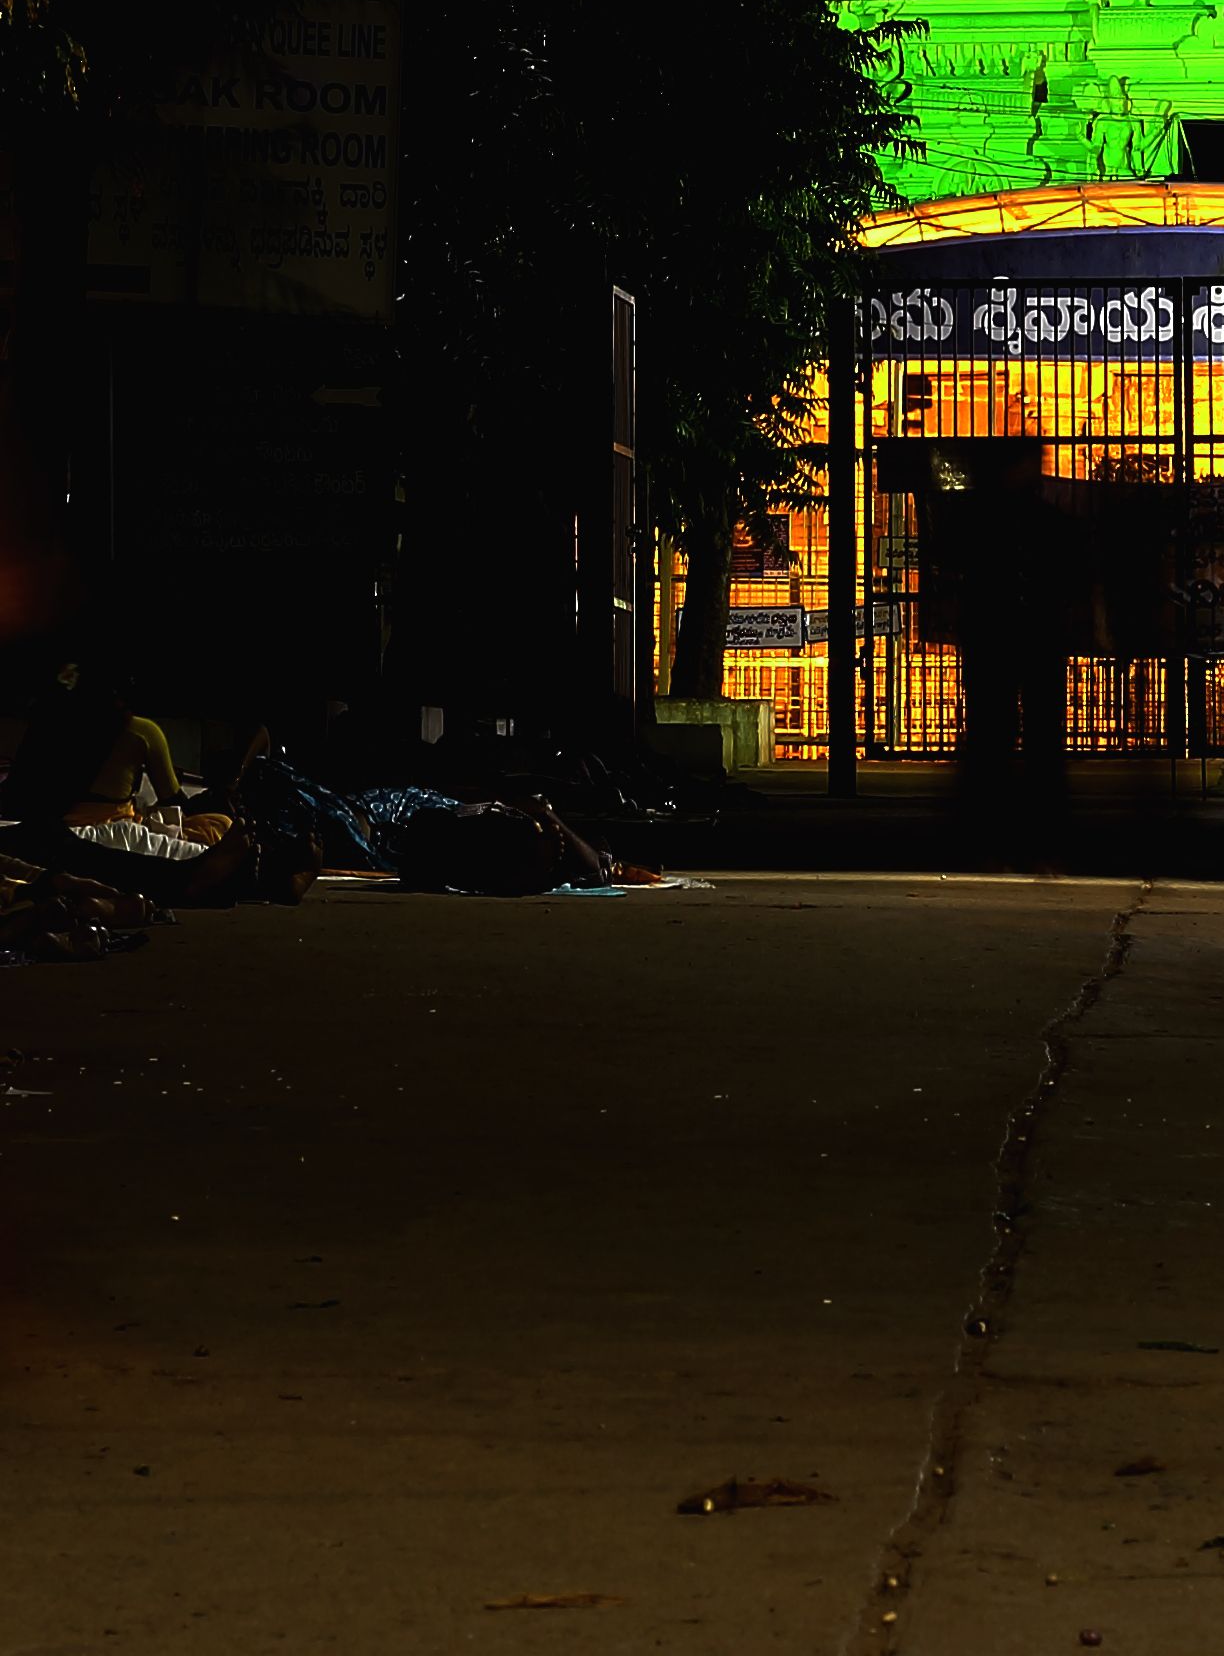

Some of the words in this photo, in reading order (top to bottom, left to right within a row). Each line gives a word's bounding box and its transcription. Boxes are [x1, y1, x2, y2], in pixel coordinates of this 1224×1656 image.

[271, 22, 331, 57] QUEE
[336, 23, 386, 60] LINE
[256, 80, 387, 116] ROOM
[301, 131, 387, 170] ROOM
